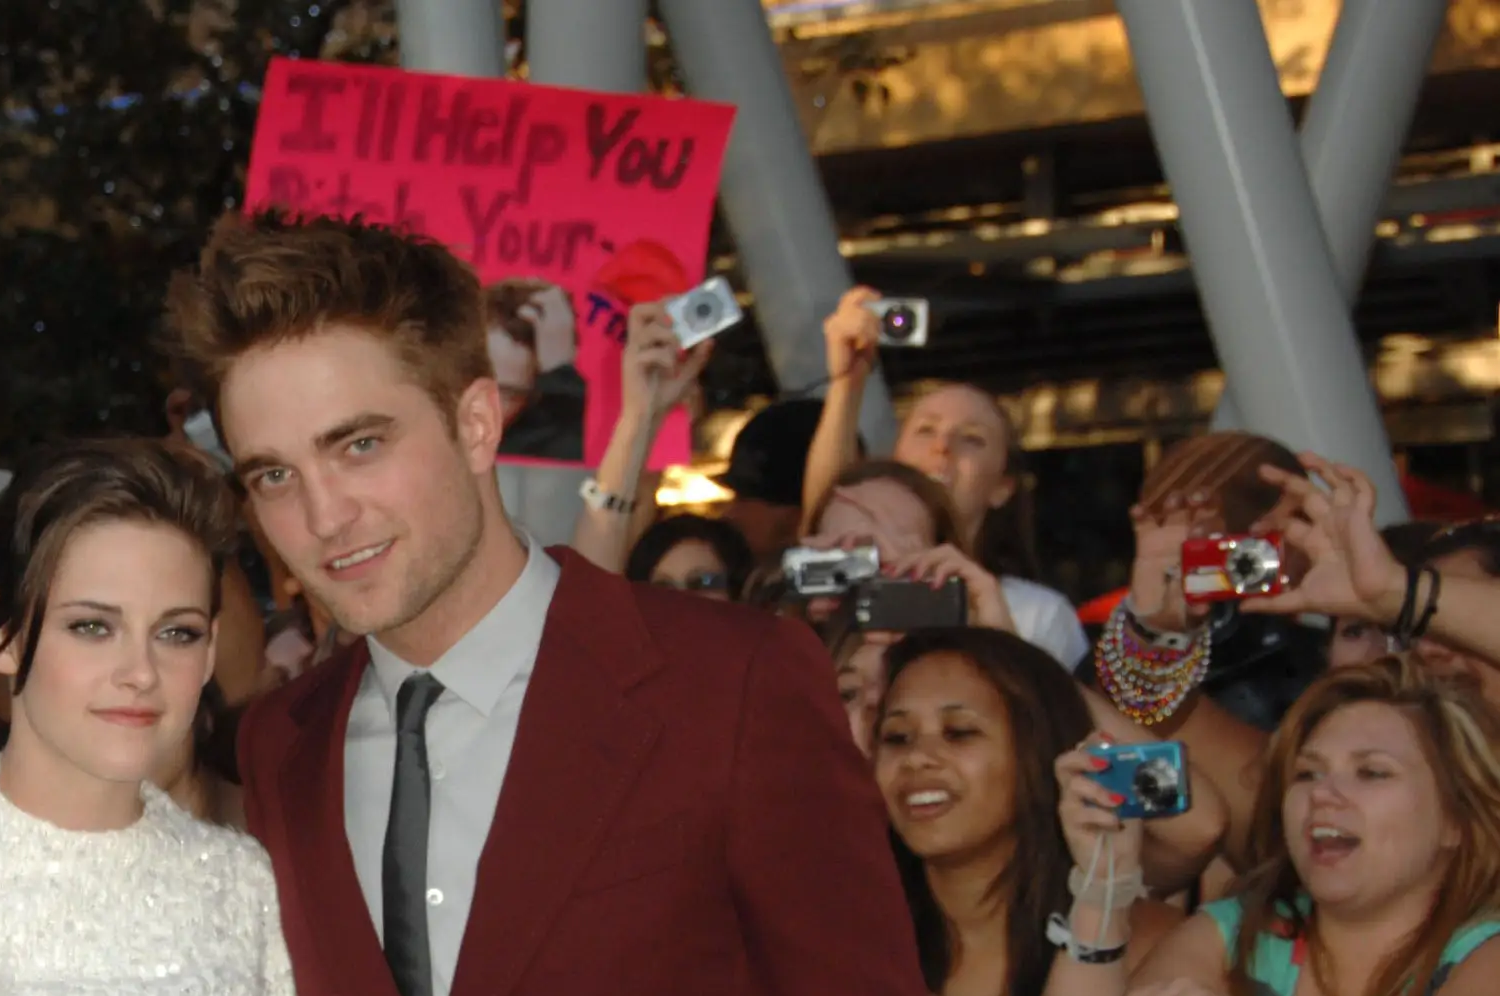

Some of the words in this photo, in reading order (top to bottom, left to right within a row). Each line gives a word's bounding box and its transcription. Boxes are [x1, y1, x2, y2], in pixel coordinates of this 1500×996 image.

[277, 72, 396, 164] I'll
[411, 91, 568, 204] Help
[584, 102, 695, 190] You
